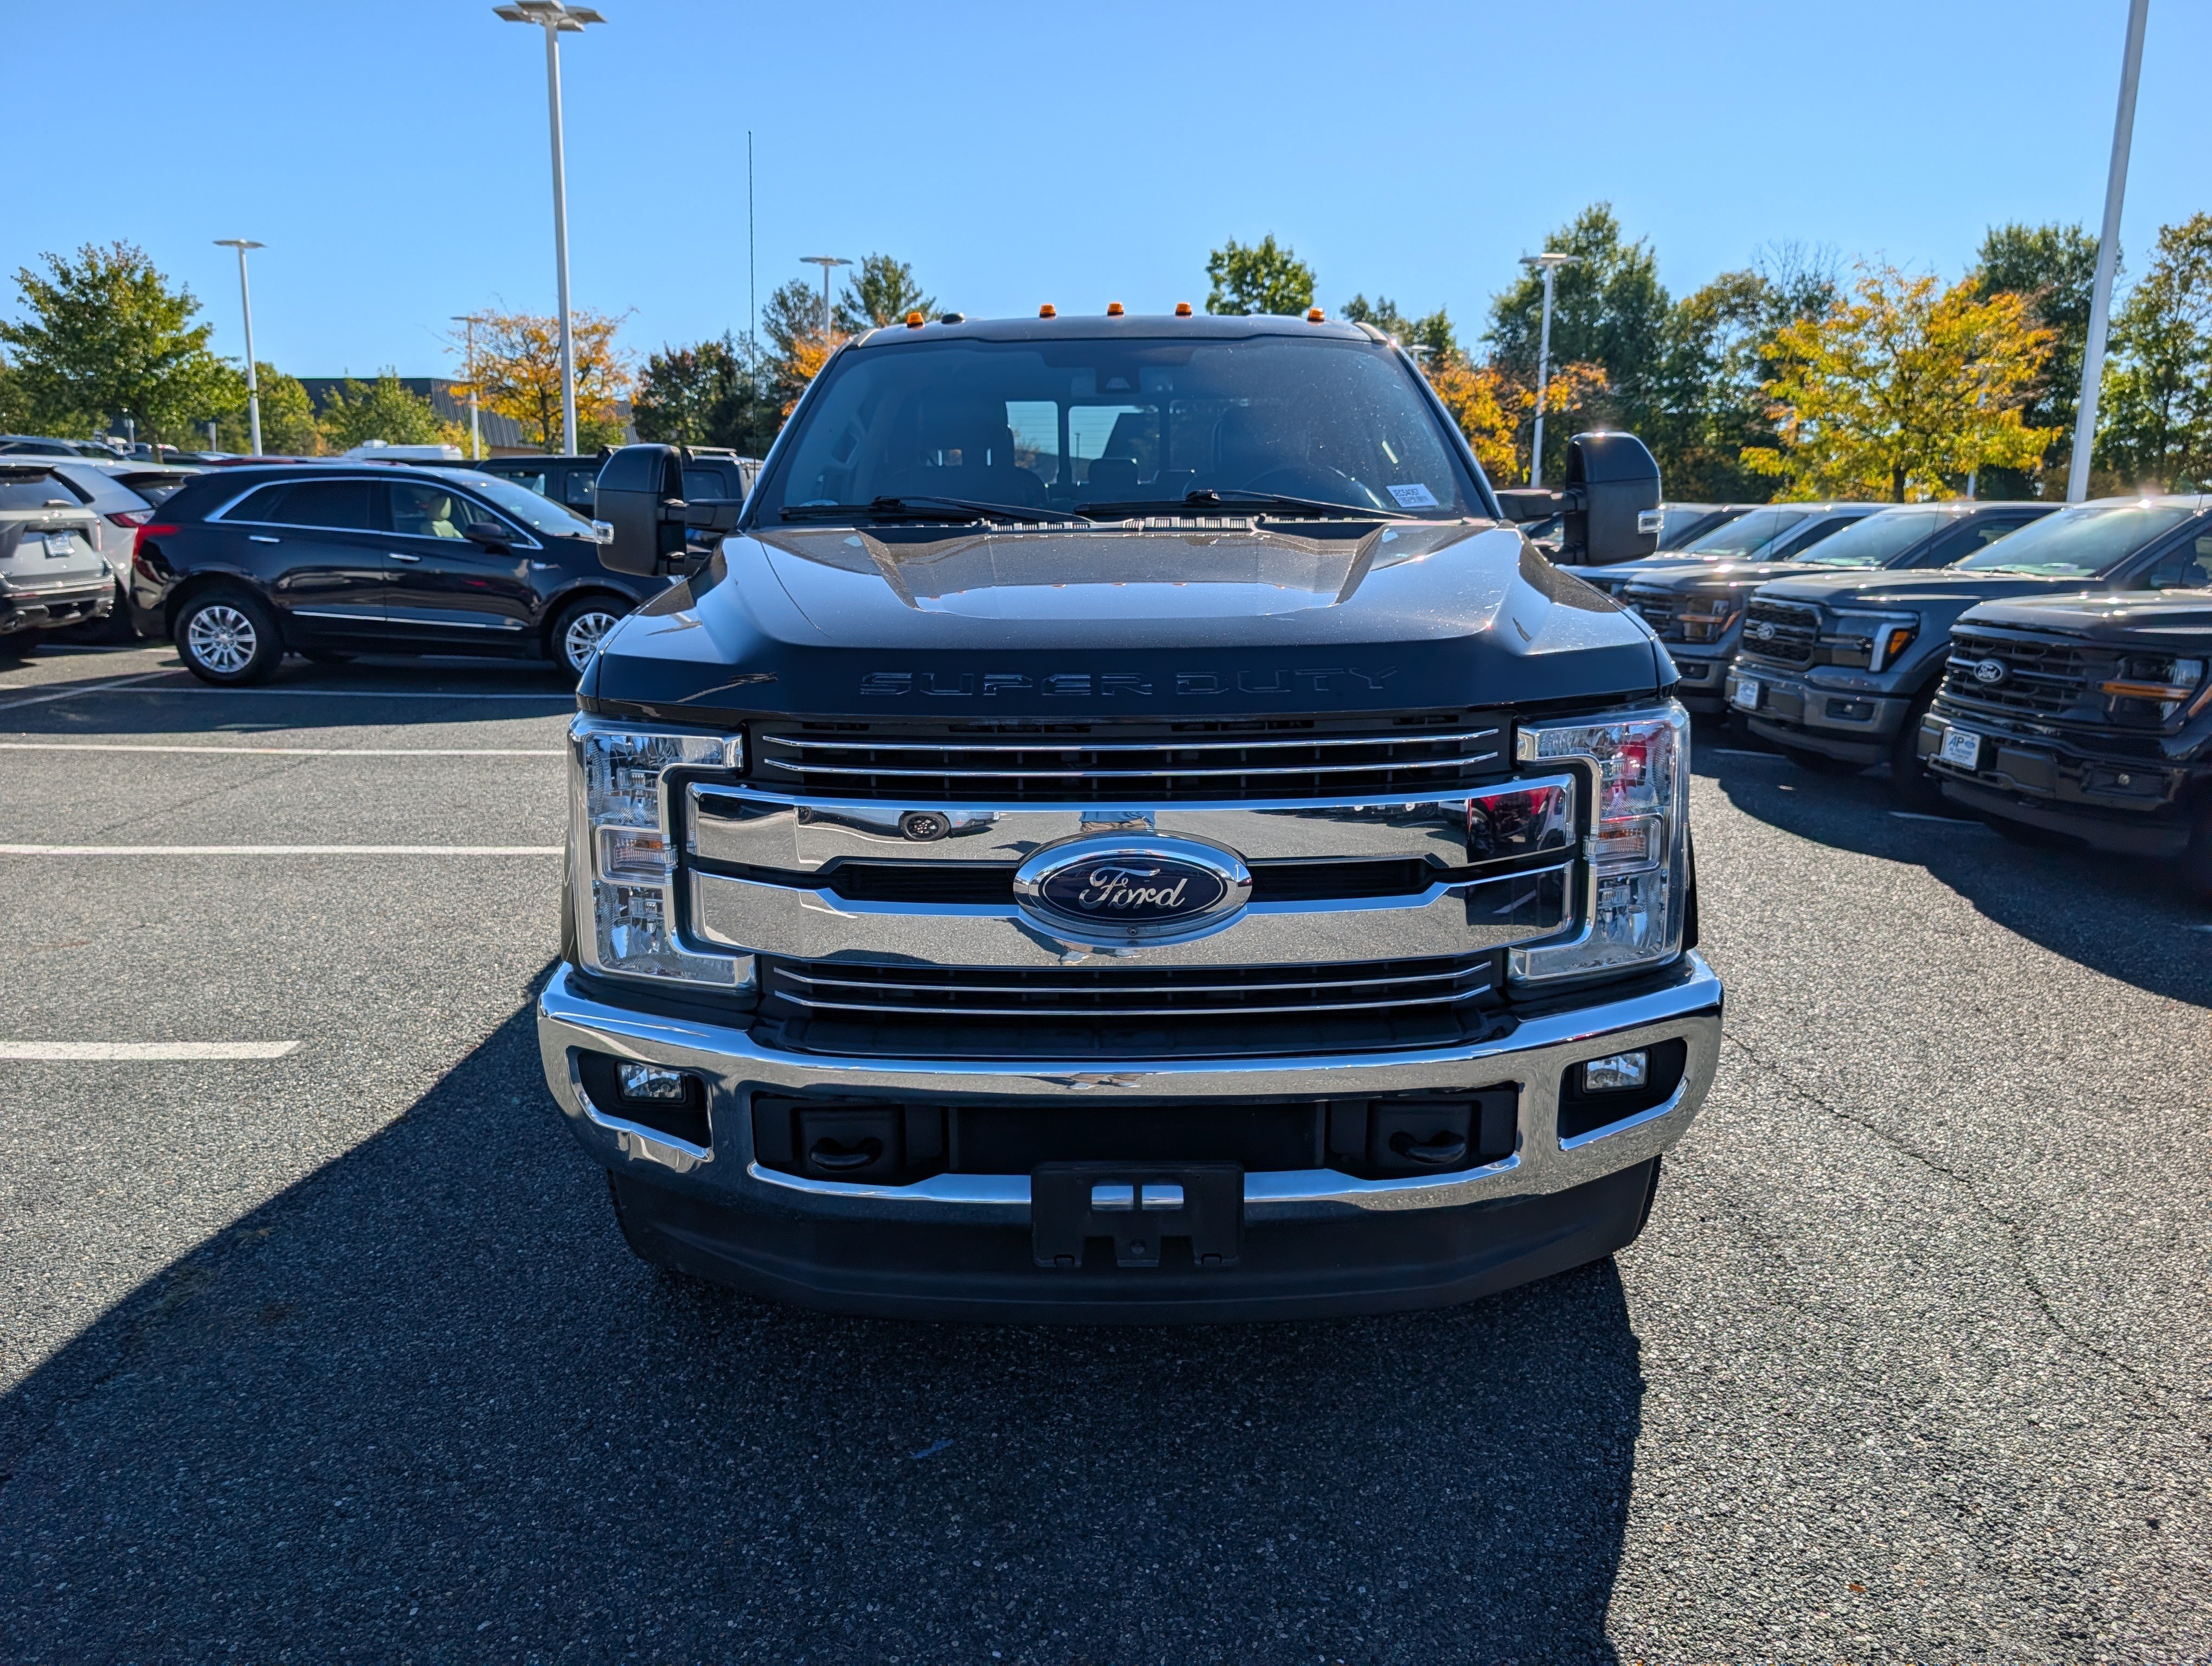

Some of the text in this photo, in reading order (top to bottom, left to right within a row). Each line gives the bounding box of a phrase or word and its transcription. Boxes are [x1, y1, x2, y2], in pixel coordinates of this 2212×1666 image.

[860, 666, 1398, 696] SUPER DUTY
[1978, 663, 1997, 678] Ford
[1078, 867, 1188, 909] Ford
